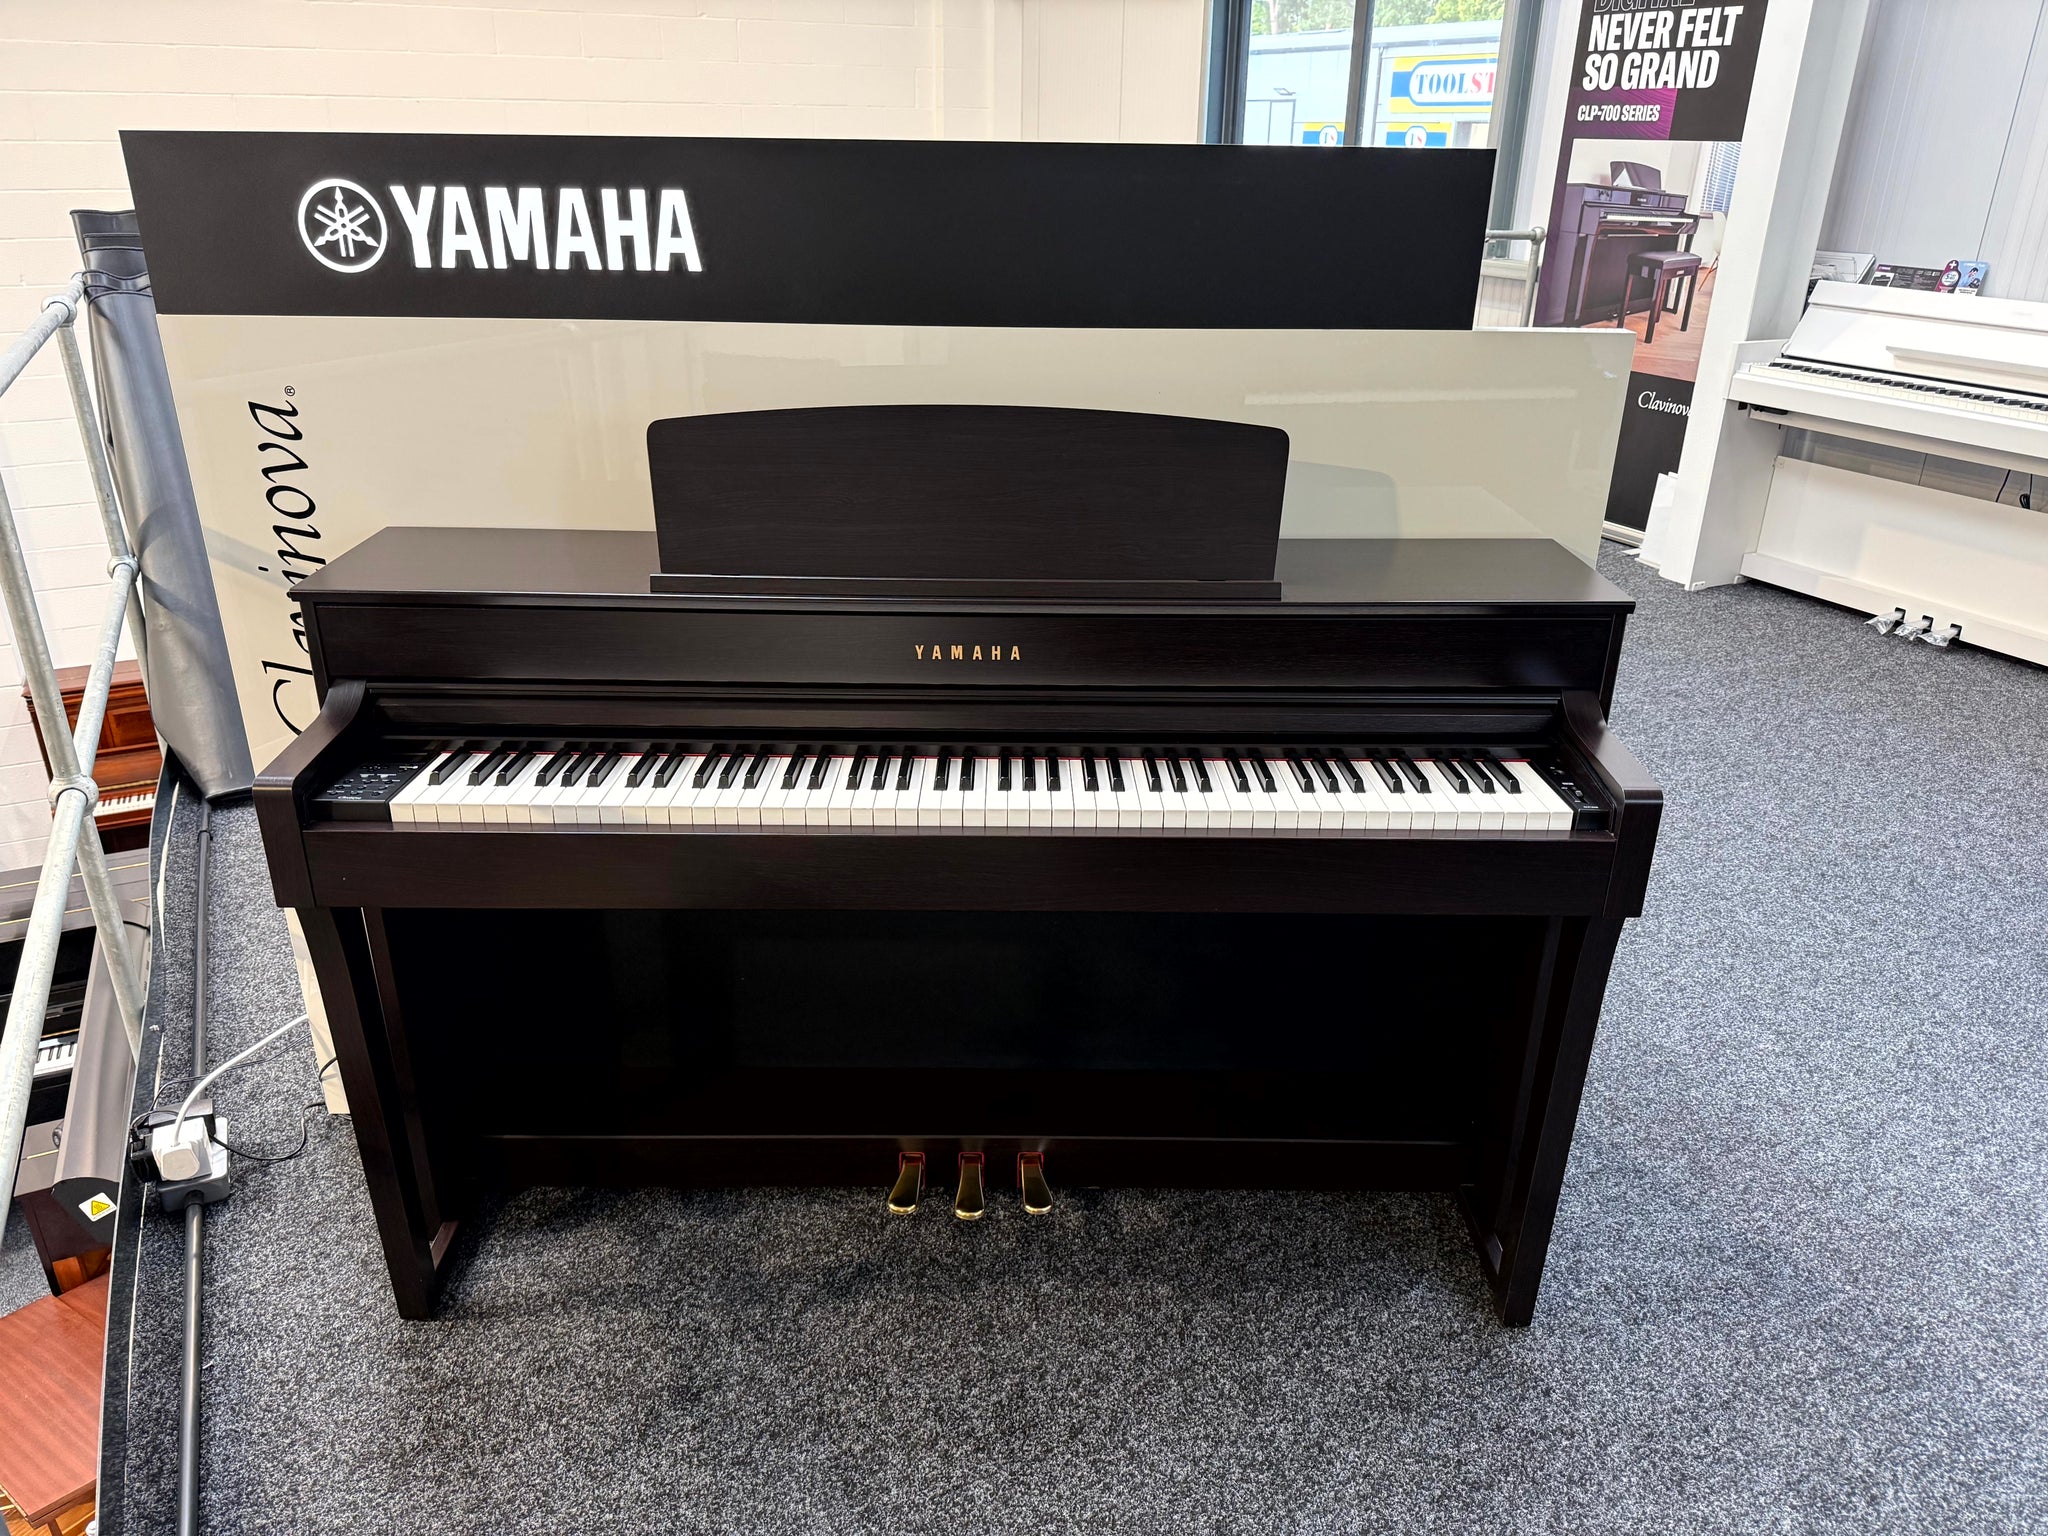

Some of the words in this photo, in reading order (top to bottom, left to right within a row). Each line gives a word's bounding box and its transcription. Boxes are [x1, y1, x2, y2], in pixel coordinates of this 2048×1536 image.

[1587, 10, 1675, 51] NEVER
[1676, 5, 1744, 48] FELT
[1582, 53, 1619, 91] SO
[1621, 50, 1720, 90] GRAND
[1577, 105, 1622, 122] CLP-700
[1621, 104, 1661, 122] SERIES
[389, 185, 703, 273] YAMAHA
[914, 644, 1021, 661] YAMAHA
